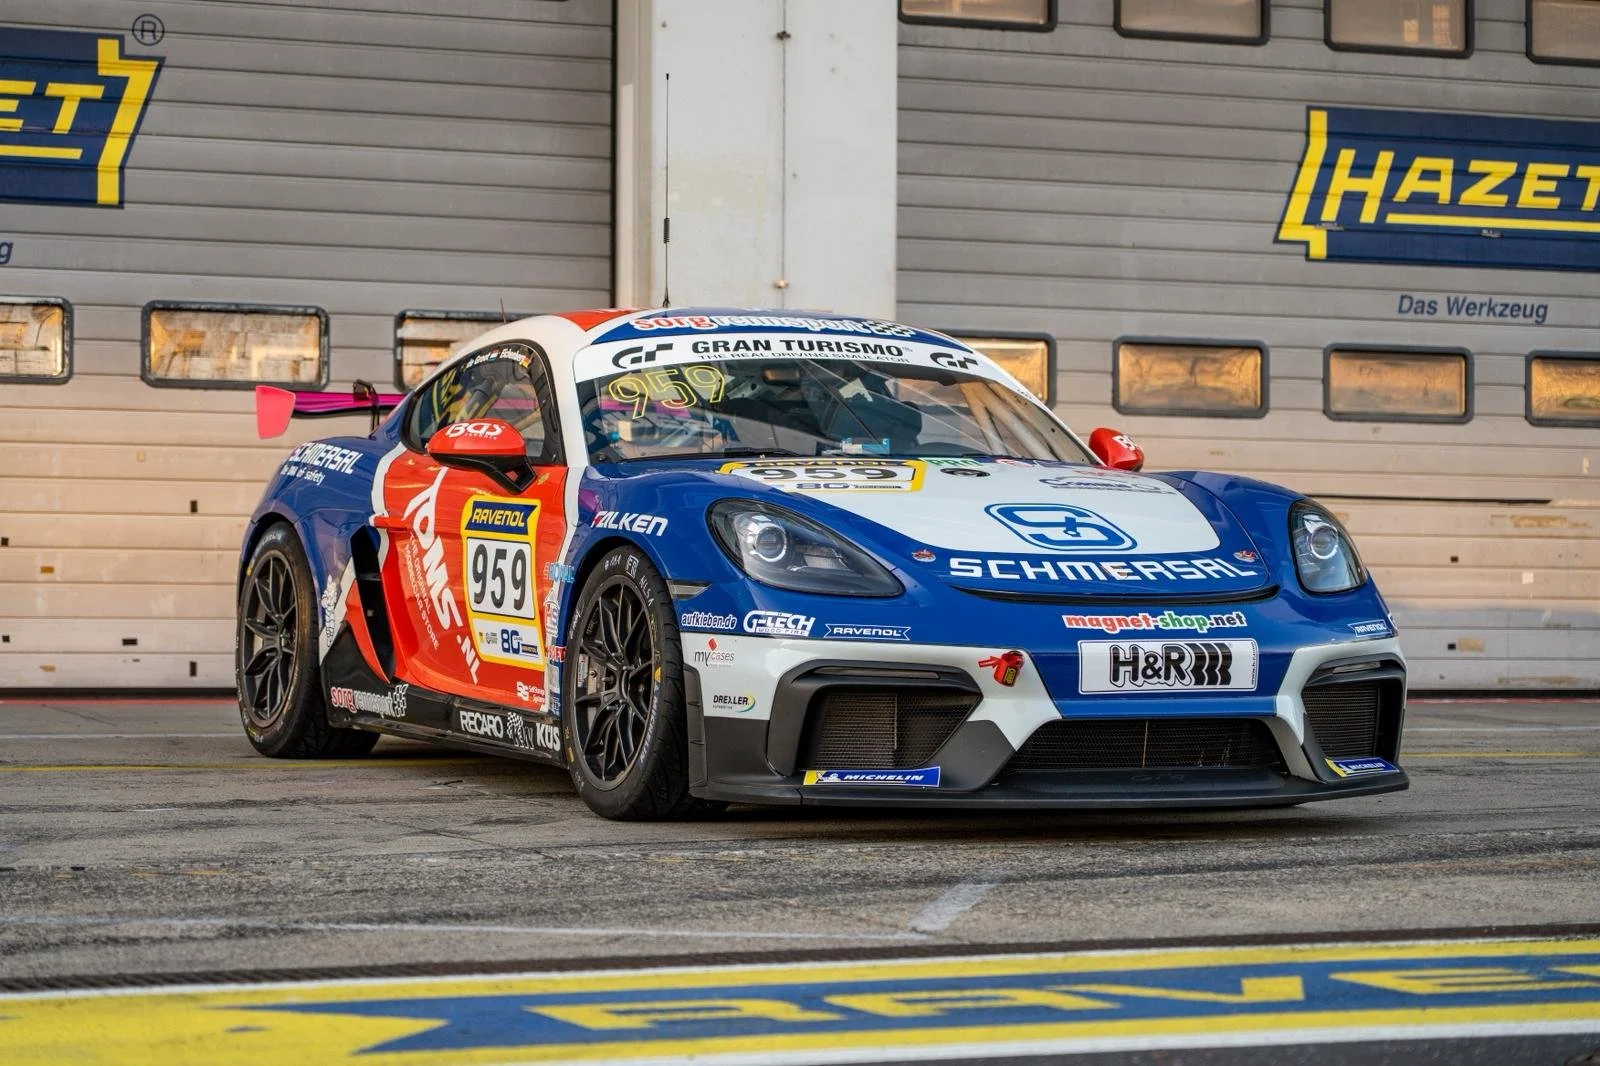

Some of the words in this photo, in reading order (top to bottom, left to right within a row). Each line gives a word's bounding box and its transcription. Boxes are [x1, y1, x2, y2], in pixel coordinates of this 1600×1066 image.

[1397, 295, 1438, 317] Das
[1446, 296, 1549, 324] Werkzeug
[691, 339, 773, 354] GRAN
[779, 339, 905, 358] TURISMO
[698, 353, 726, 361] THE
[832, 353, 911, 363] SIMULATOR
[608, 365, 725, 420] 959
[304, 468, 326, 486] safety
[750, 467, 898, 480] 959
[471, 507, 527, 528] RAVENOL
[590, 510, 669, 536] FALKEN
[472, 543, 528, 611] 959
[949, 556, 1259, 581] SCHMERSAL
[420, 610, 440, 650] STORE
[682, 612, 738, 629] aufkleben.de
[1065, 611, 1246, 633] magnet-shop.net
[832, 626, 902, 637] RAVENOL
[694, 650, 736, 667] mycases
[1109, 643, 1193, 687] H&R
[459, 711, 504, 738] RECARO
[843, 773, 925, 781] MICHELIN
